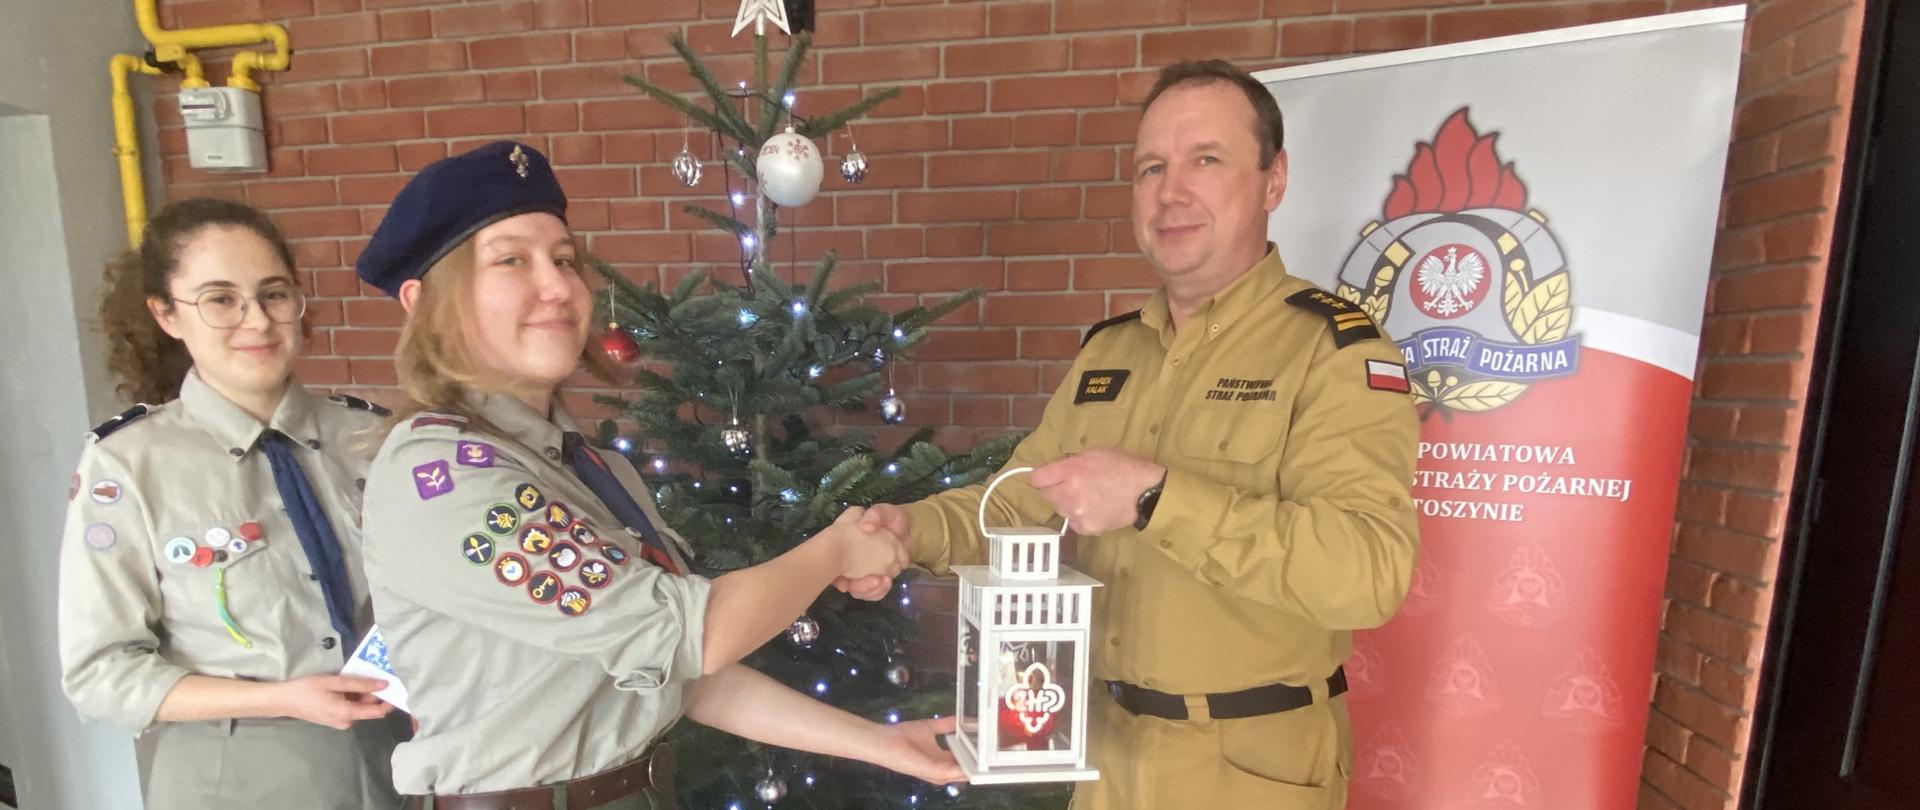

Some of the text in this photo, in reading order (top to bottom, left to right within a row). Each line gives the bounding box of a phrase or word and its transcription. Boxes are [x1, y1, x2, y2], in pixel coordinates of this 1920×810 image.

[1423, 336, 1471, 359] STRAŻ
[1479, 347, 1568, 373] POŻARNA
[1417, 442, 1576, 465] POWIATOWA
[1502, 472, 1632, 502] POŻARNEJ
